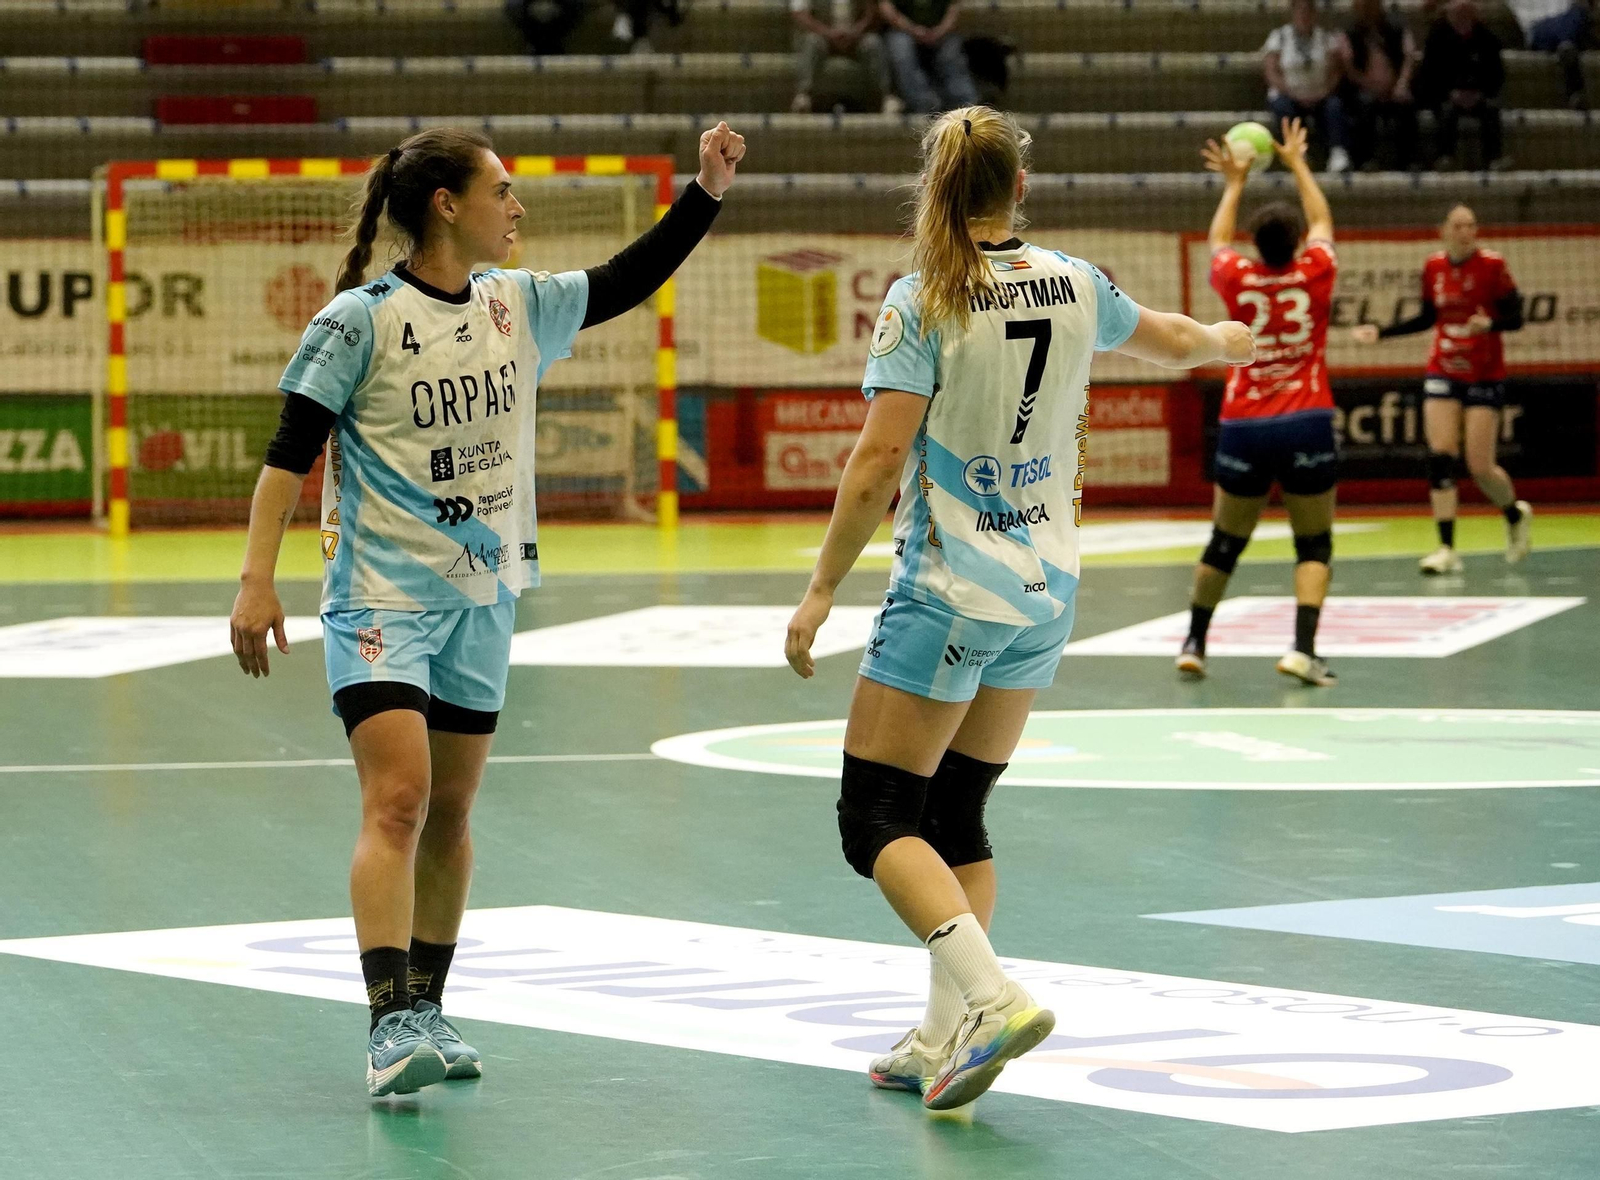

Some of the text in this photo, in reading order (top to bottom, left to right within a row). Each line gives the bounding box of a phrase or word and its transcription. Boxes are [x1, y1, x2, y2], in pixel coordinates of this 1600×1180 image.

[966, 275, 1077, 312] HAUPTMAN
[1236, 287, 1315, 346] 23
[401, 322, 421, 355] 4
[1005, 317, 1052, 444] 7
[458, 440, 501, 460] XUNTA
[458, 461, 476, 476] DE
[1009, 453, 1052, 488] TESOL
[1023, 581, 1046, 593] ZICO
